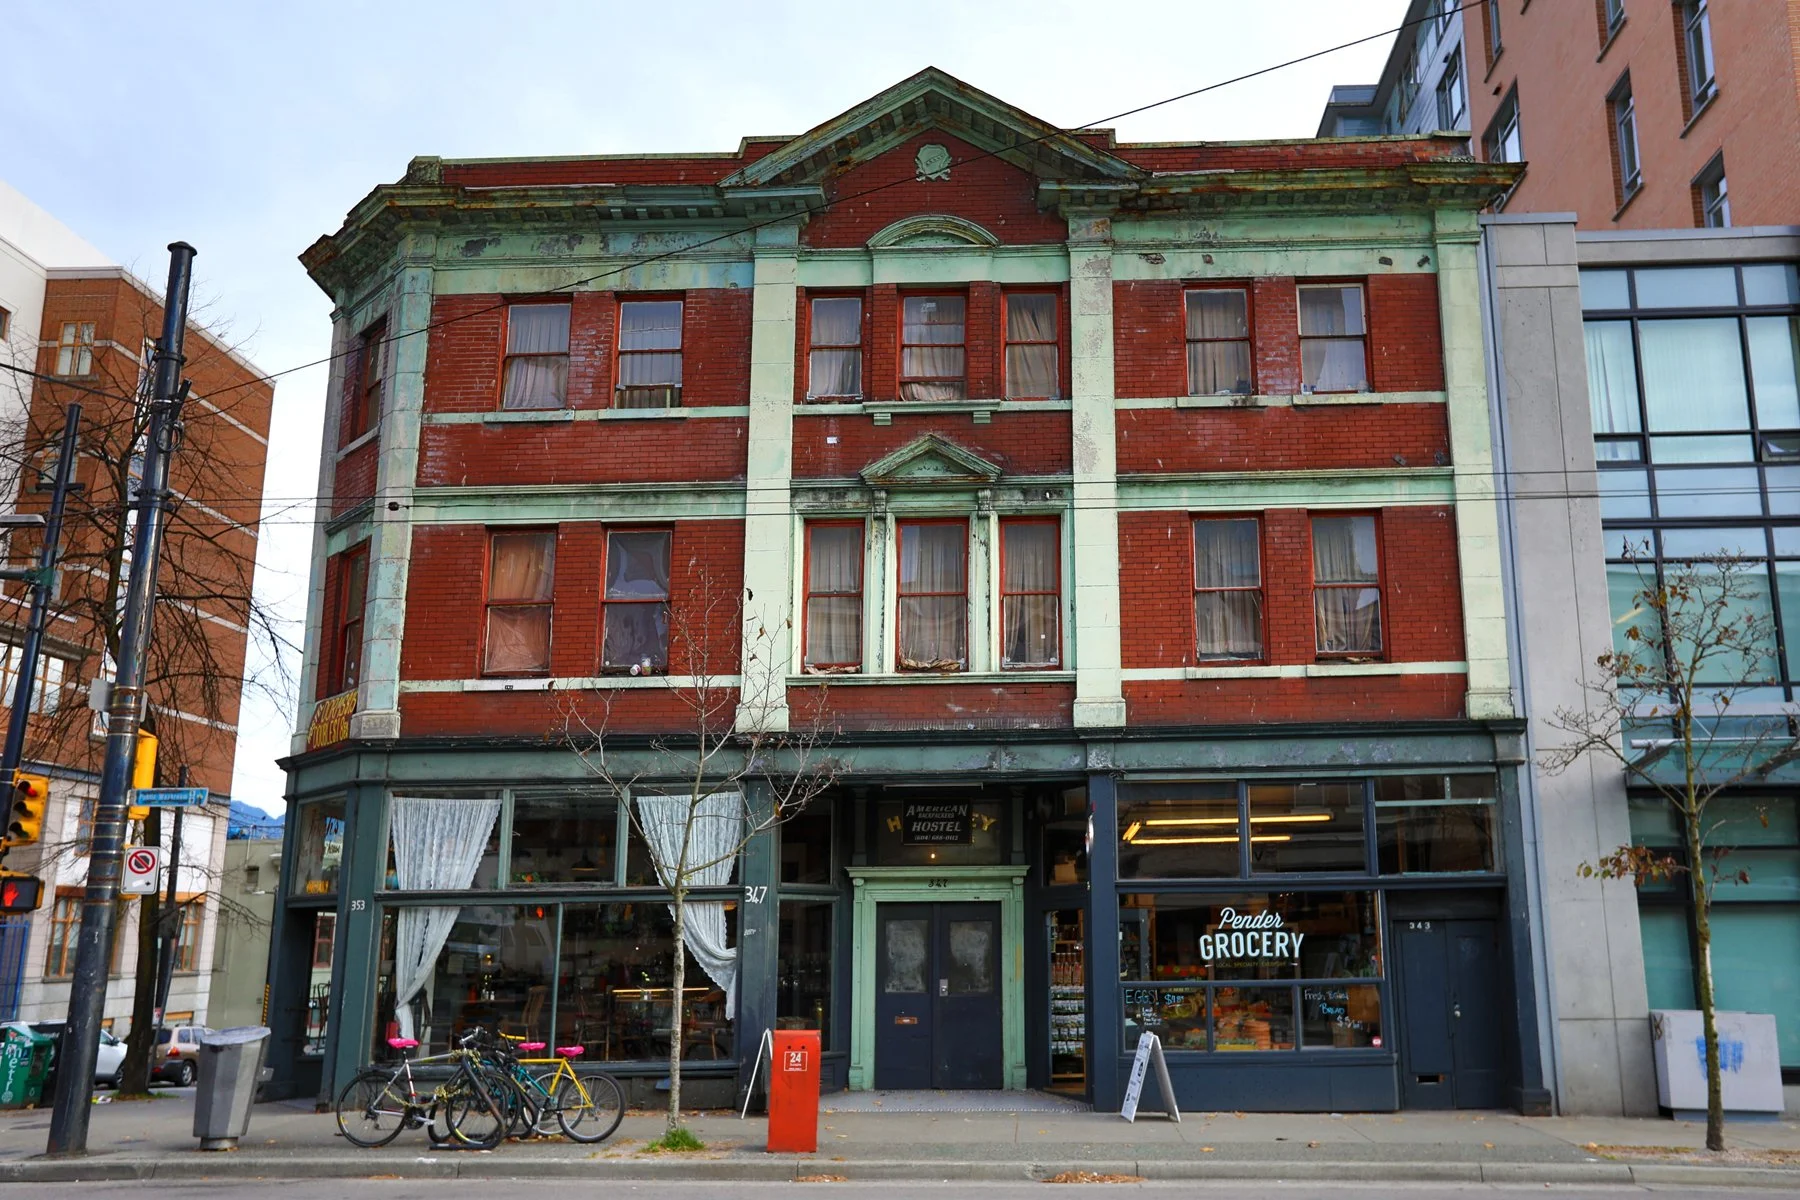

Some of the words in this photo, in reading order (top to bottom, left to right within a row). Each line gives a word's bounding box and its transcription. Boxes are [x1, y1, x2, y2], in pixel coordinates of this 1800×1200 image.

[906, 804, 968, 817] AMERICAN
[912, 821, 961, 832] HOSTEL
[928, 879, 950, 888] 347
[745, 886, 768, 904] 347
[351, 900, 366, 911] 353
[1218, 907, 1284, 929] Pender
[1409, 921, 1431, 930] 343
[1199, 931, 1305, 961] GROCERY
[1125, 989, 1160, 1005] EGGS!
[790, 1052, 802, 1063] 24
